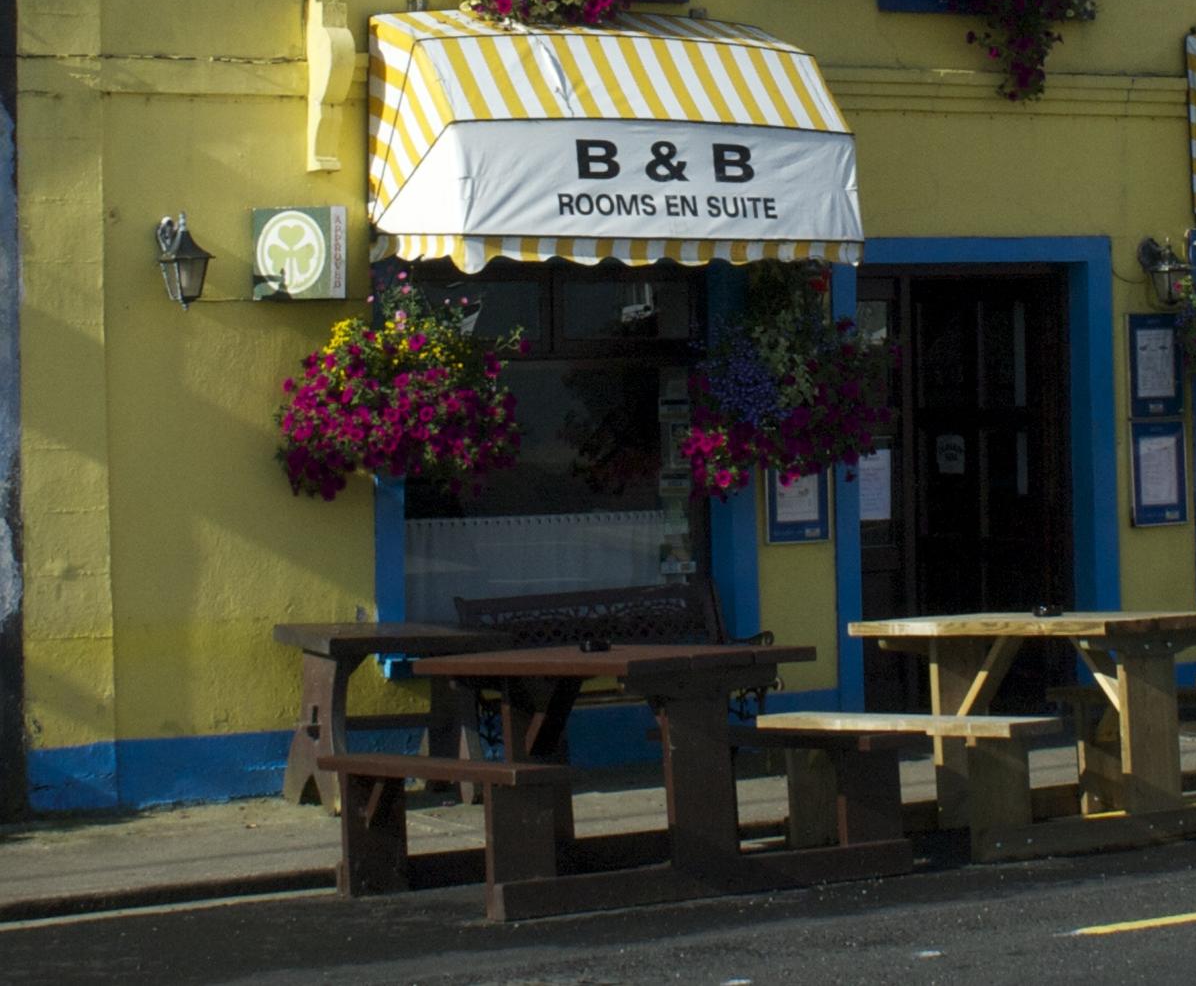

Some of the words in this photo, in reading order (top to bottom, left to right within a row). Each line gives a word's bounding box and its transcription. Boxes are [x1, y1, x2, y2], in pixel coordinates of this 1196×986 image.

[576, 139, 620, 180] B
[645, 140, 689, 182] &
[712, 143, 756, 183] B
[557, 192, 656, 216] ROOMS
[666, 195, 698, 218] EN
[706, 196, 778, 220] SUITE
